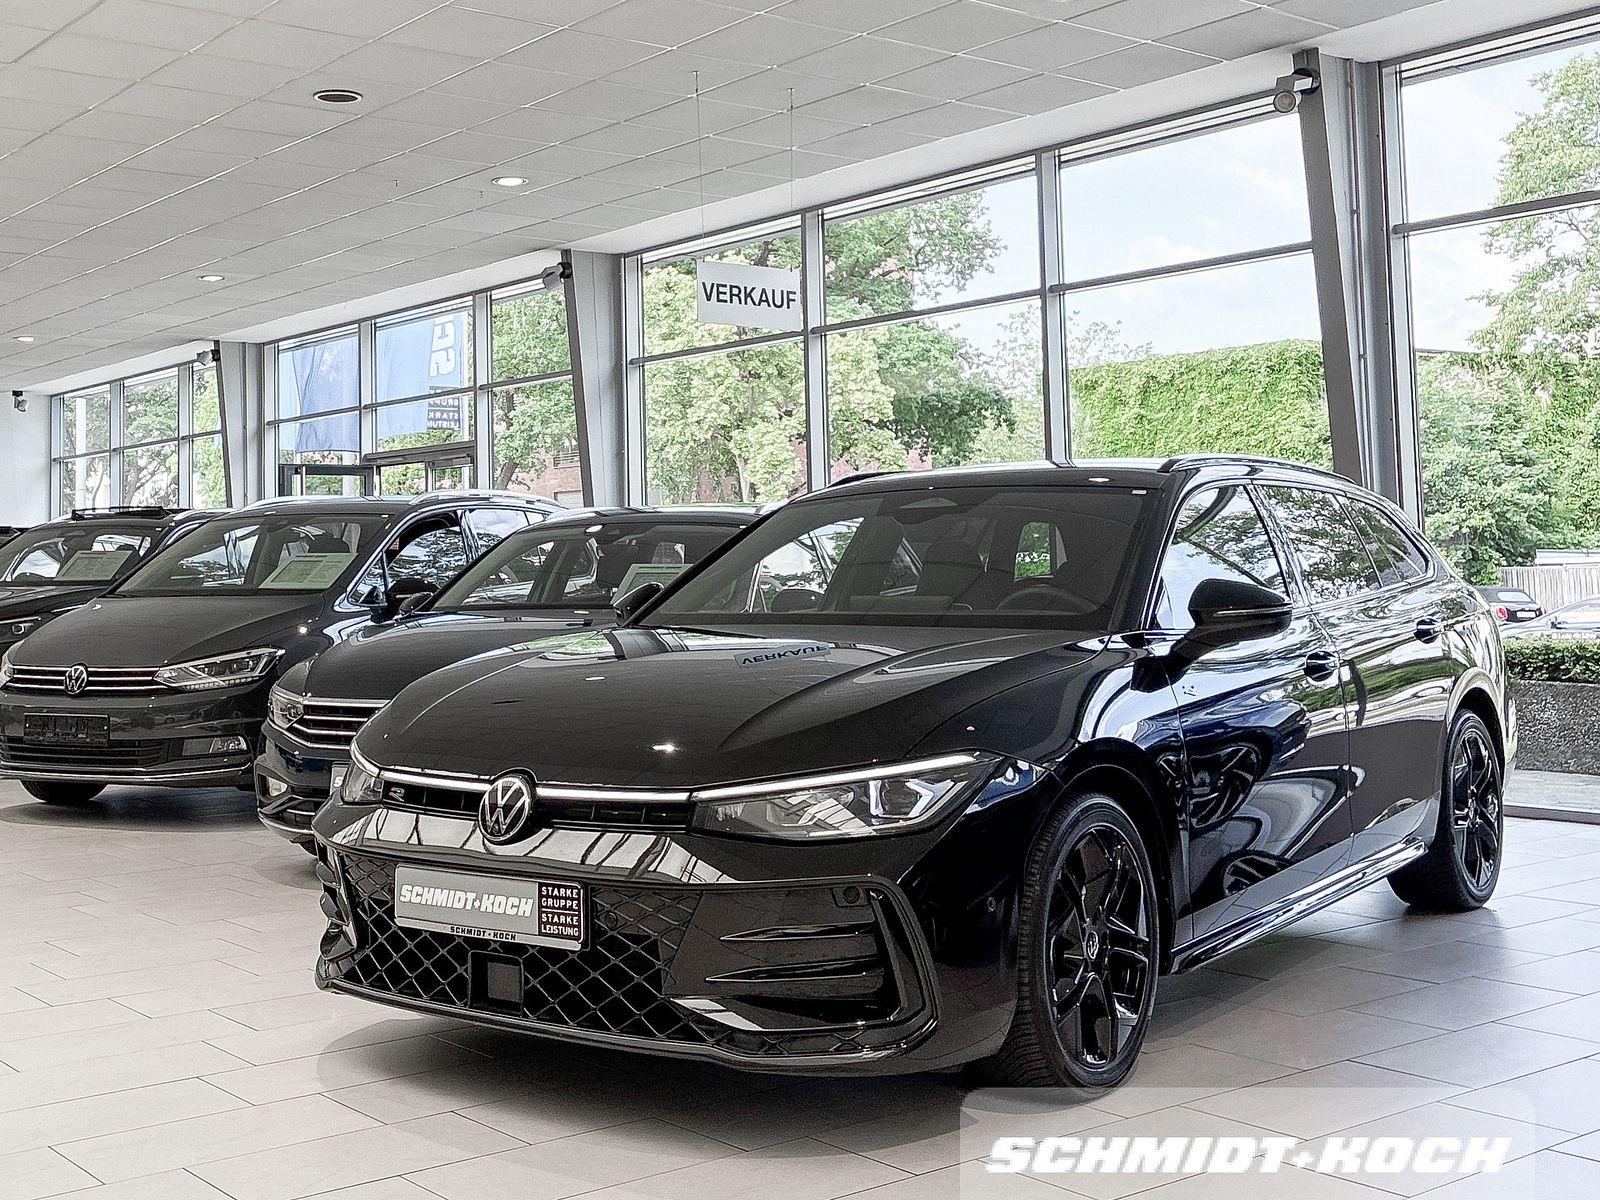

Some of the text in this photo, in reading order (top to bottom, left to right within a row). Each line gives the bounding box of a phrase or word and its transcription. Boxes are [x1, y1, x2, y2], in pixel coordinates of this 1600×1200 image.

[702, 281, 797, 310] VERKAUF
[541, 886, 579, 898] STARKE
[541, 897, 579, 910] GRUPPE
[541, 913, 579, 925] STARKE
[541, 924, 579, 936] LEISTUNG
